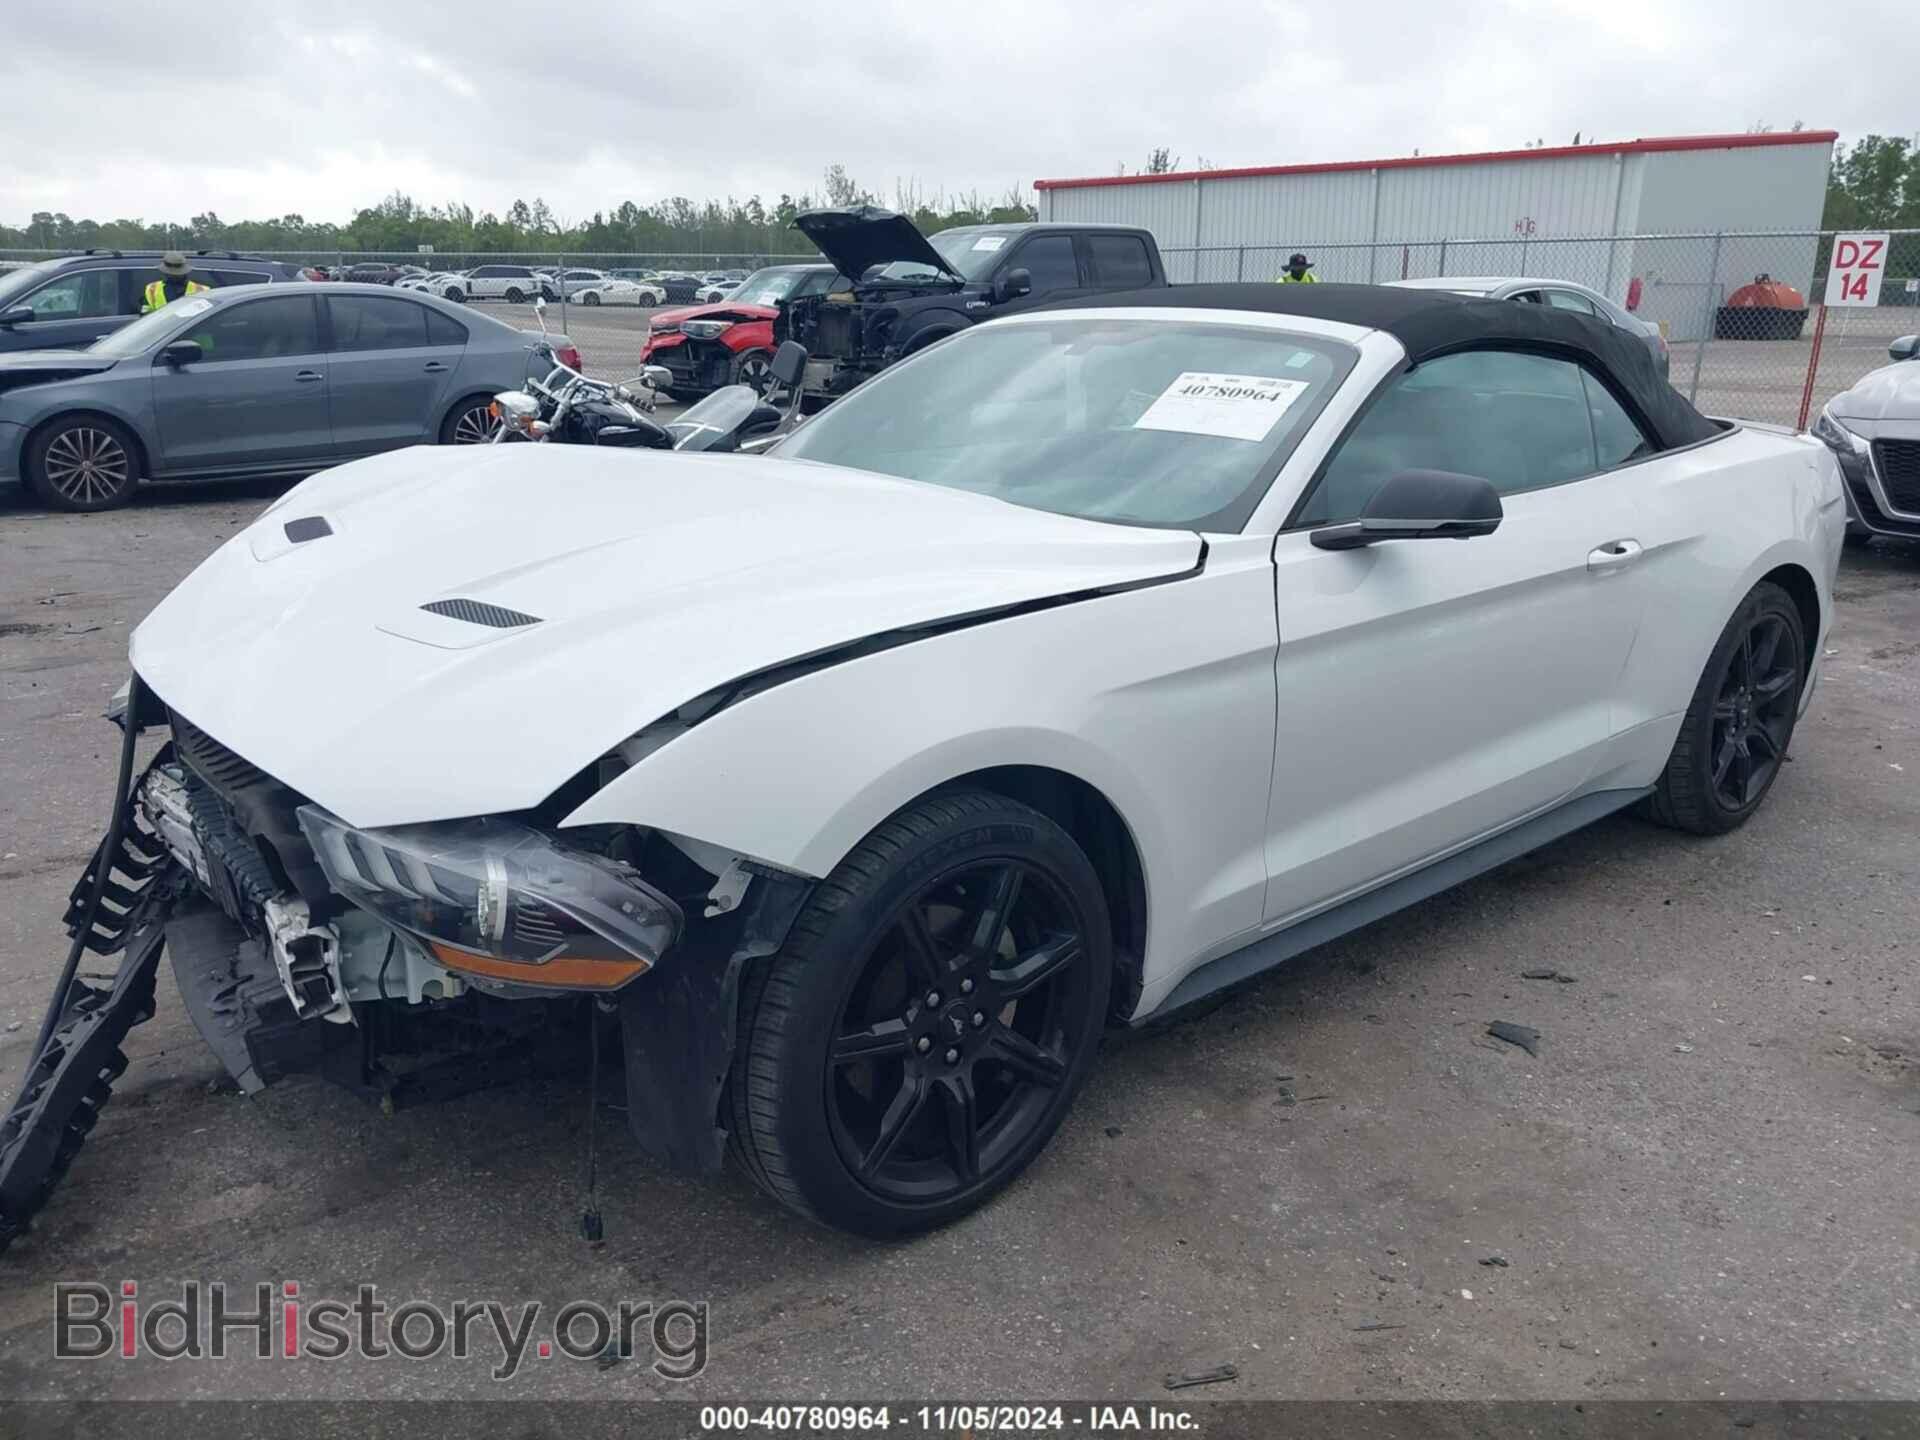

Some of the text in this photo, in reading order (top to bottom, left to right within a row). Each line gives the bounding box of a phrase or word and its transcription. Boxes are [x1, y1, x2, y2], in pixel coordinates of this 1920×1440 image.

[1835, 239, 1884, 269] DZ
[1840, 272, 1869, 301] 14
[1178, 384, 1282, 402] 40780964
